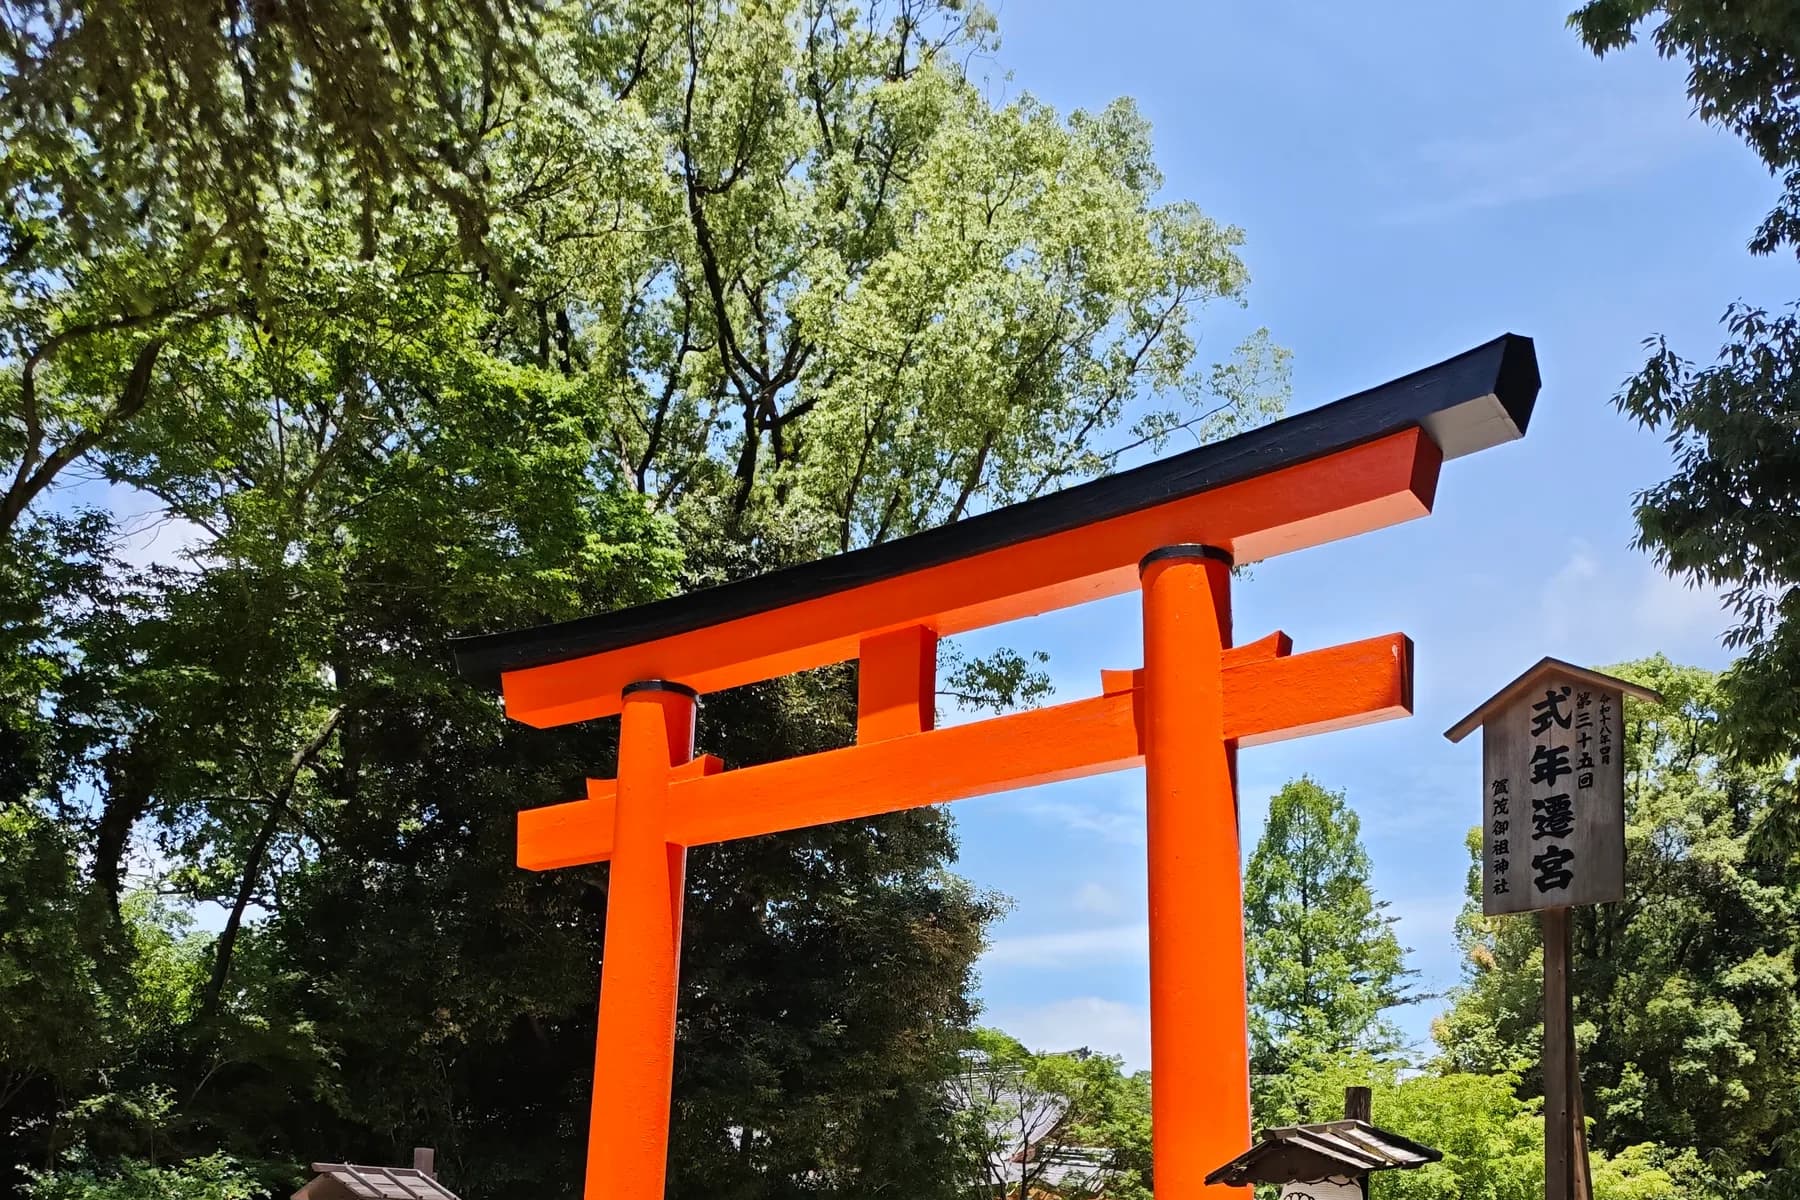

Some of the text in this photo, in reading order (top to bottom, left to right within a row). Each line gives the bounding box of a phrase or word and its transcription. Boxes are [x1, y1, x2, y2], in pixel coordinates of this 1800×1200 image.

[1575, 691, 1595, 790] 第三十五回
[1599, 693, 1612, 765] 令和十八年四月
[1491, 778, 1510, 896] 賀茂御祖神社
[1529, 686, 1575, 894] 式年遷宮
